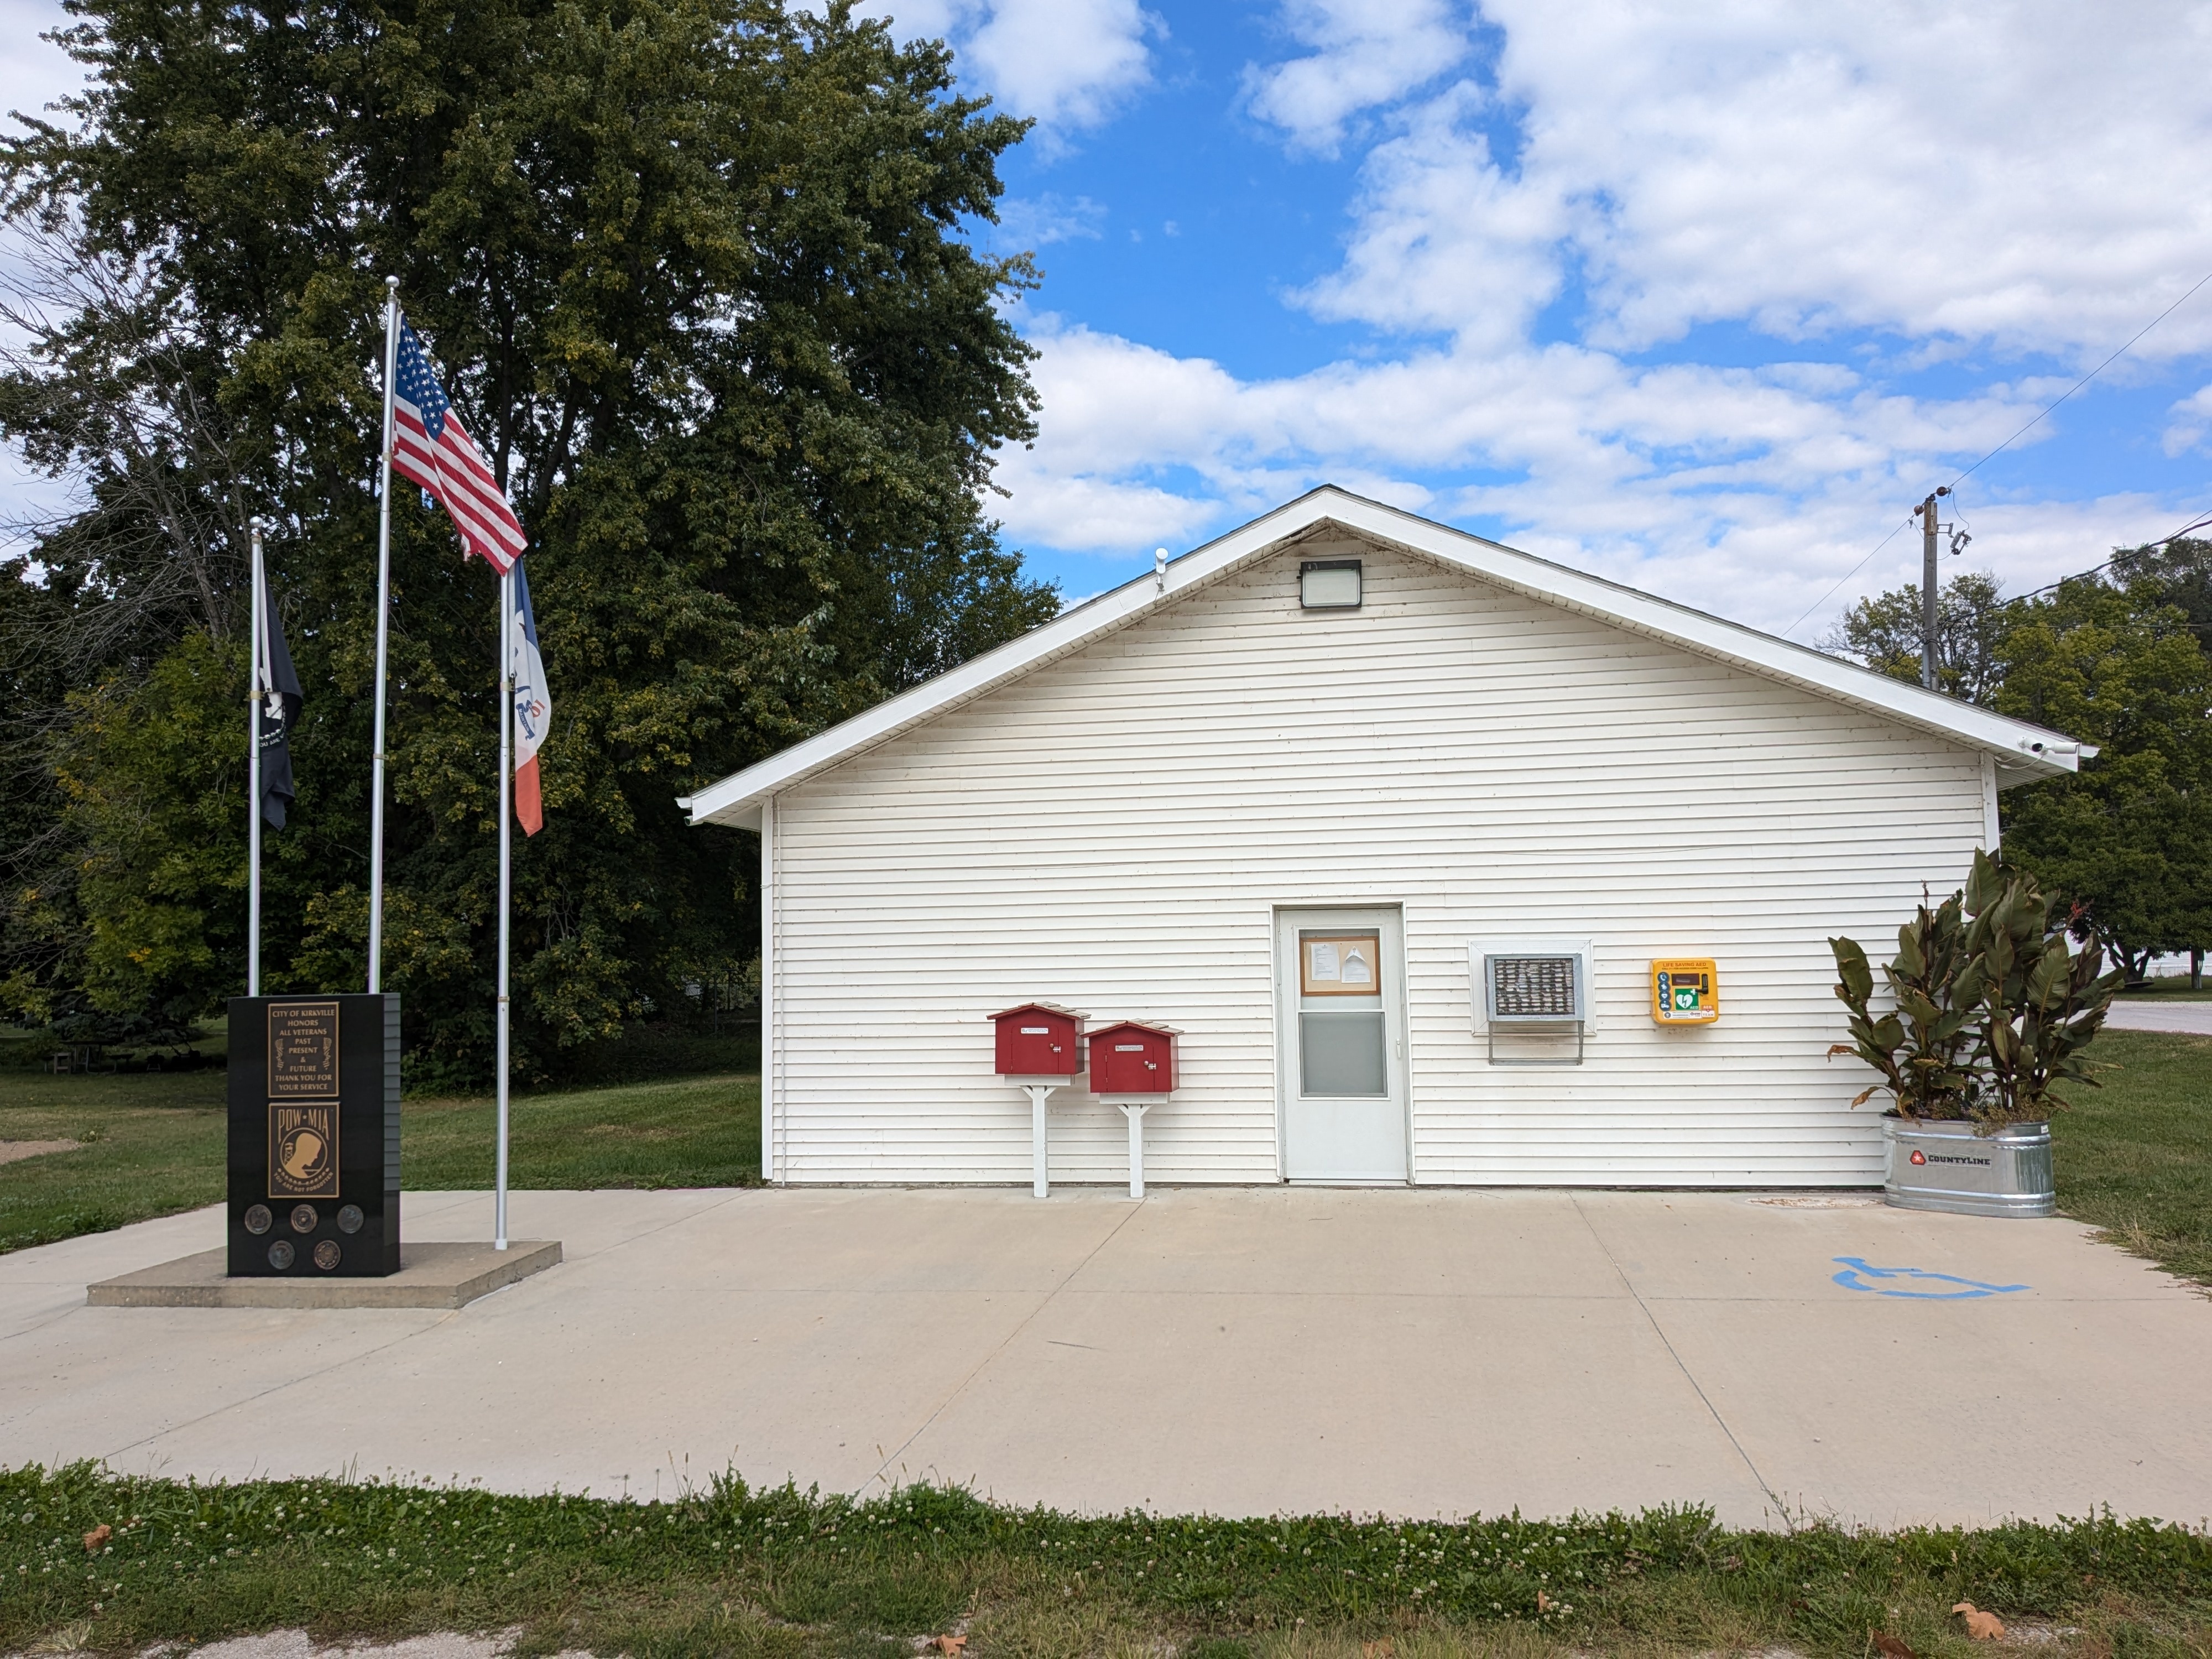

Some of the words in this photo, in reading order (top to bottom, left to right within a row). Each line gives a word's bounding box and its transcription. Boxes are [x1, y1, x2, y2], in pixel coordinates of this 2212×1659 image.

[519, 708, 530, 732] MAINTAIN
[278, 1109, 302, 1145] POW
[308, 1108, 330, 1140] MIA
[1928, 1155, 1991, 1165] COUNTYLINE
[274, 1172, 283, 1183] YOU
[283, 1182, 293, 1190] ARE
[306, 1172, 333, 1192] FORGOTTEN
